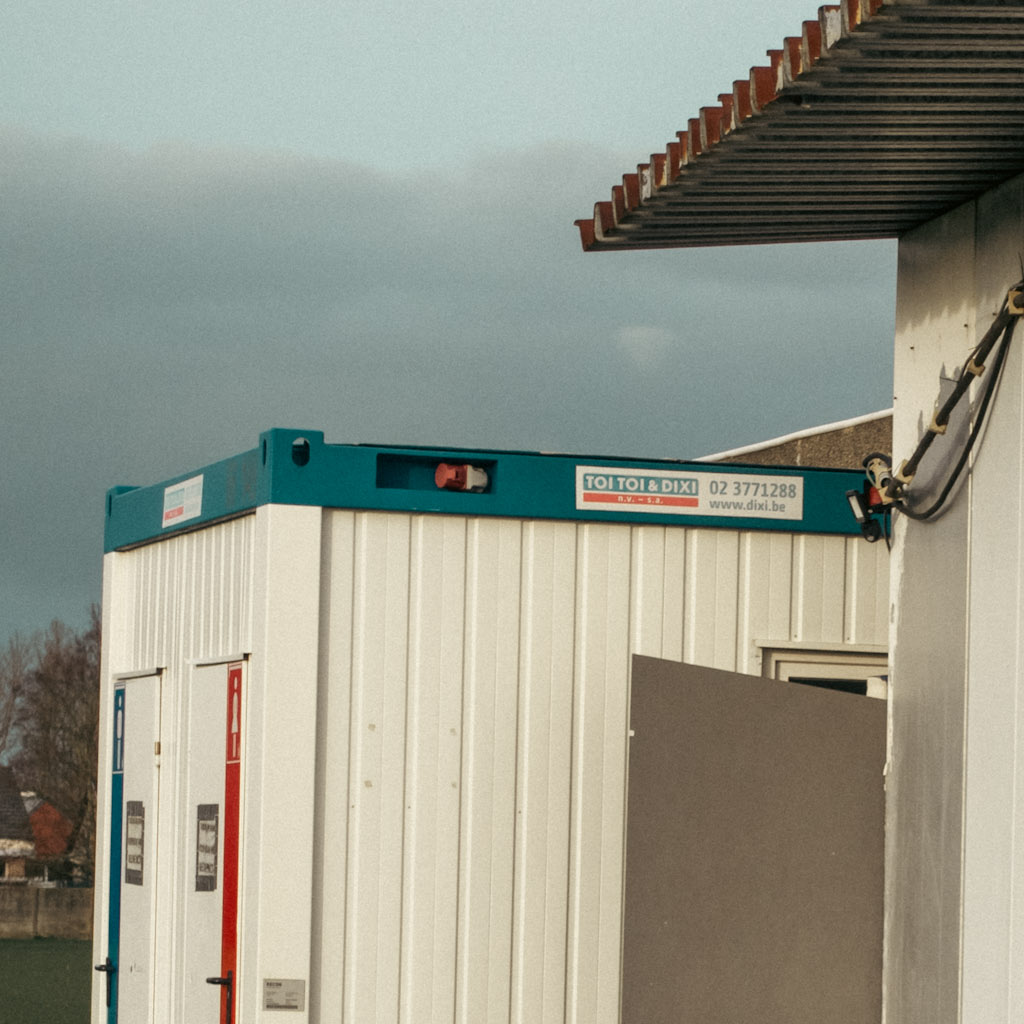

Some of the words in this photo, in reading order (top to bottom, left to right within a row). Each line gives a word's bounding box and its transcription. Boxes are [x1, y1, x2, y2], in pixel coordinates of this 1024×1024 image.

[585, 475, 613, 490] TOI
[617, 477, 645, 491] TOI
[647, 479, 659, 492] &
[661, 479, 697, 494] DIXI
[709, 480, 728, 496] 02
[733, 481, 797, 499] 3771288
[617, 495, 635, 503] n.v.
[647, 496, 664, 504] s.a.
[709, 499, 786, 513] www.dixi.be
